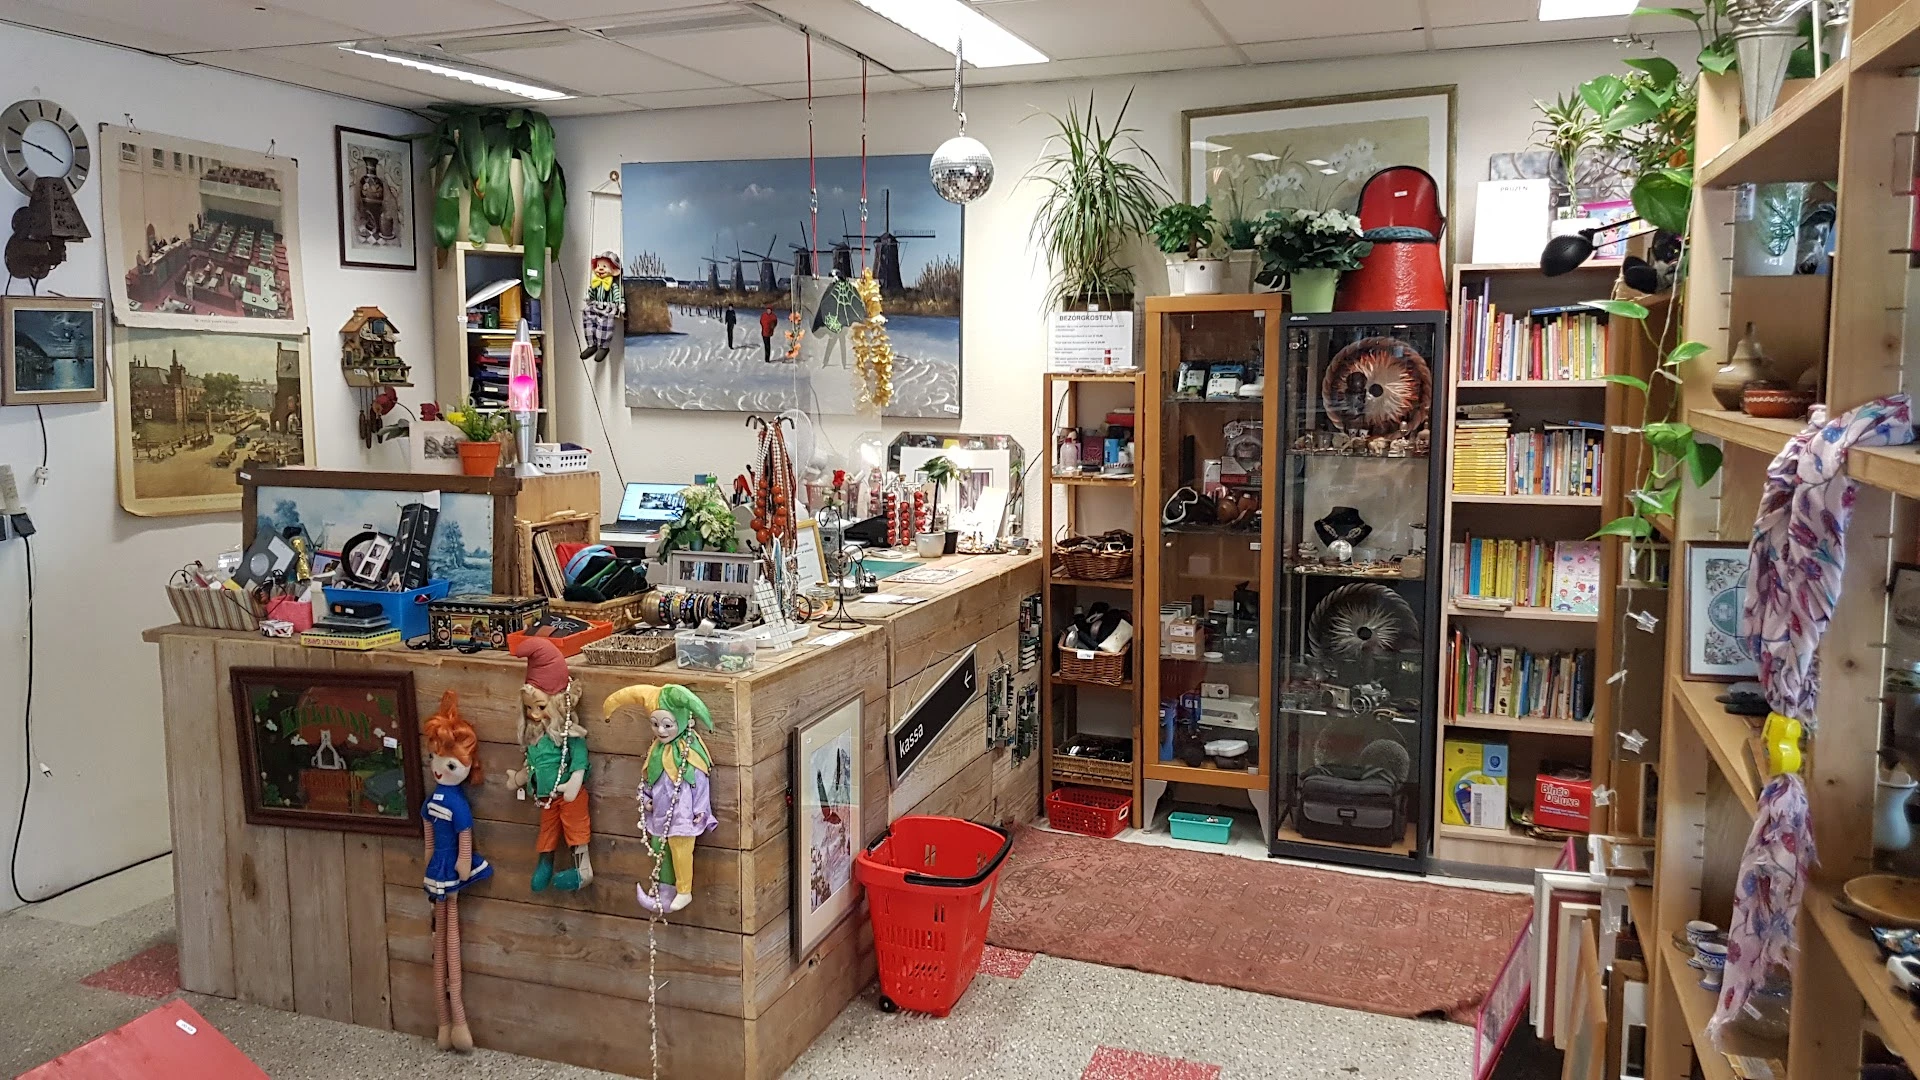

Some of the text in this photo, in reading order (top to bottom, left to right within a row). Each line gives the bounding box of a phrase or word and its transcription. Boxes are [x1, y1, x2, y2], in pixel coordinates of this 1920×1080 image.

[899, 724, 923, 757] kassa
[1541, 784, 1568, 796] Bingo
[1545, 793, 1579, 806] Deluxe
